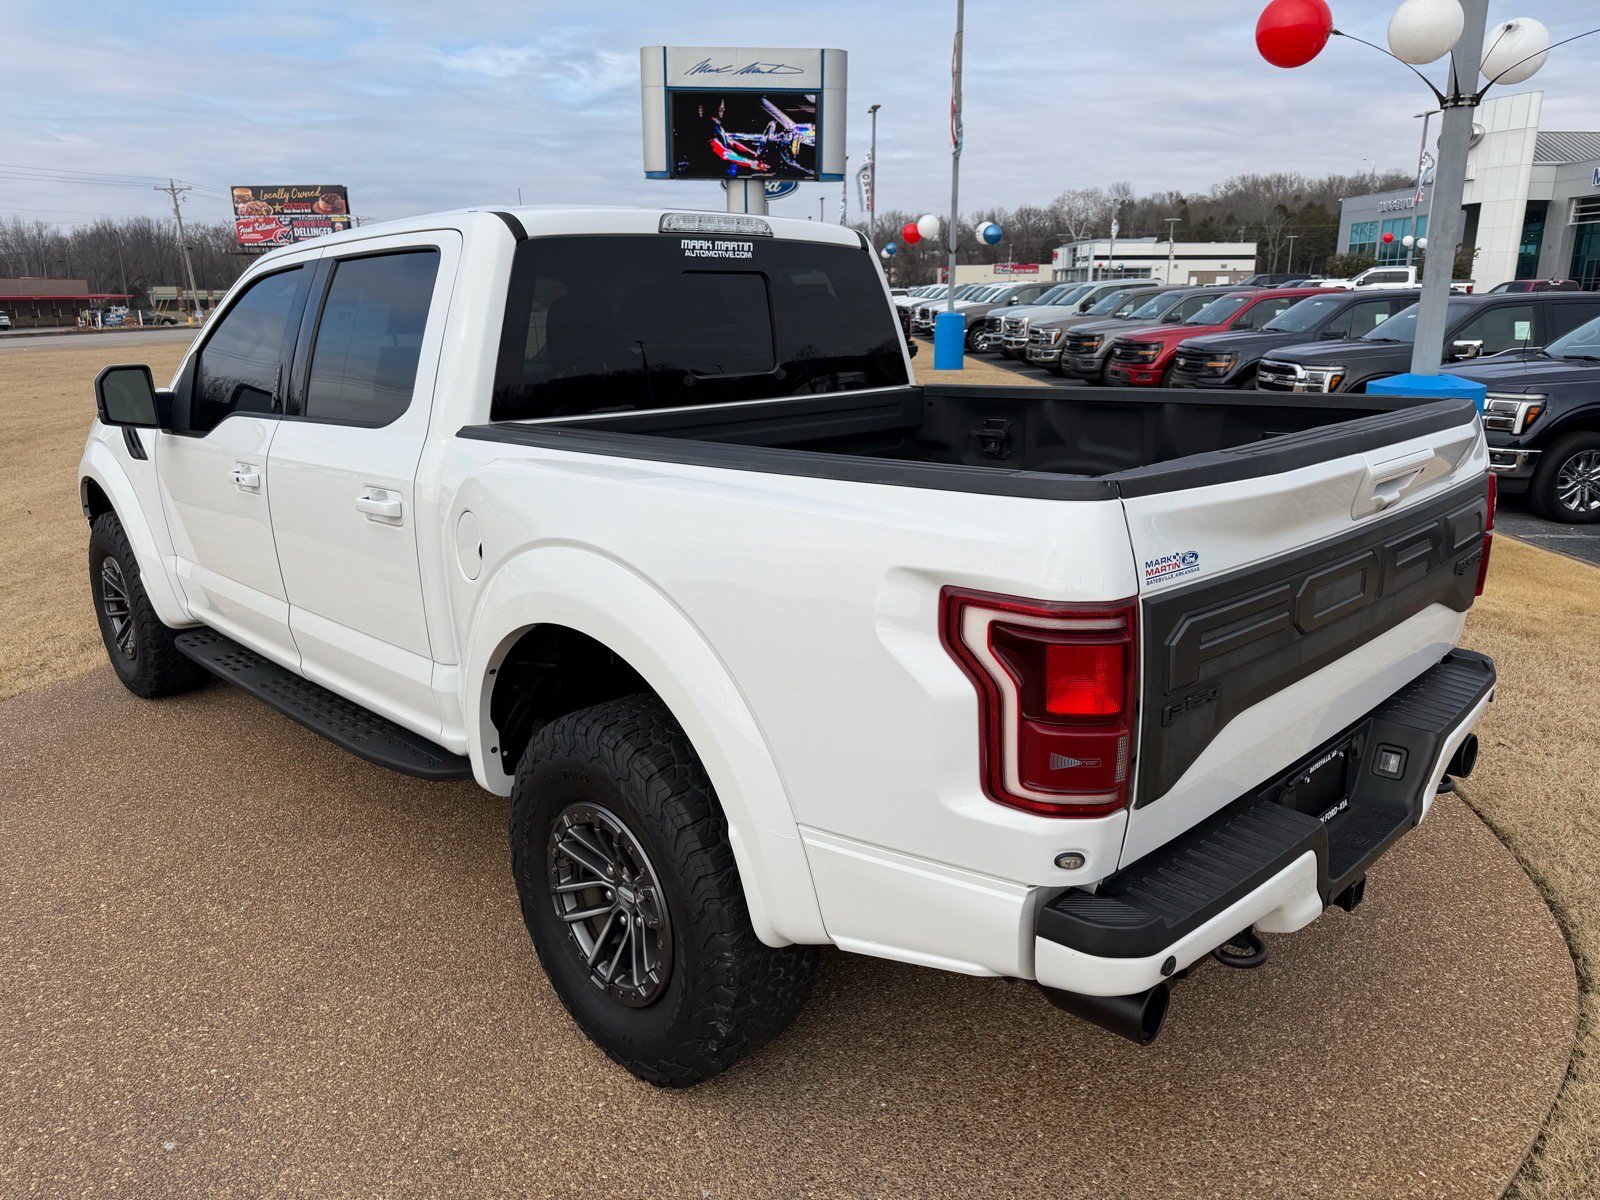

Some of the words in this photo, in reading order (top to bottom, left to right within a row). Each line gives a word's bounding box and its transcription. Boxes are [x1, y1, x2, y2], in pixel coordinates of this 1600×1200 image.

[260, 187, 290, 202] Locally
[291, 186, 321, 199] Owned
[1376, 197, 1414, 212] MUSEUM
[294, 227, 333, 237] DELLINGER
[681, 240, 712, 249] MARK
[715, 241, 753, 251] MARTIN
[685, 249, 752, 258] AUTOMOTIVE.COM
[1145, 555, 1172, 569] MARK
[1145, 561, 1181, 577] MARTIN
